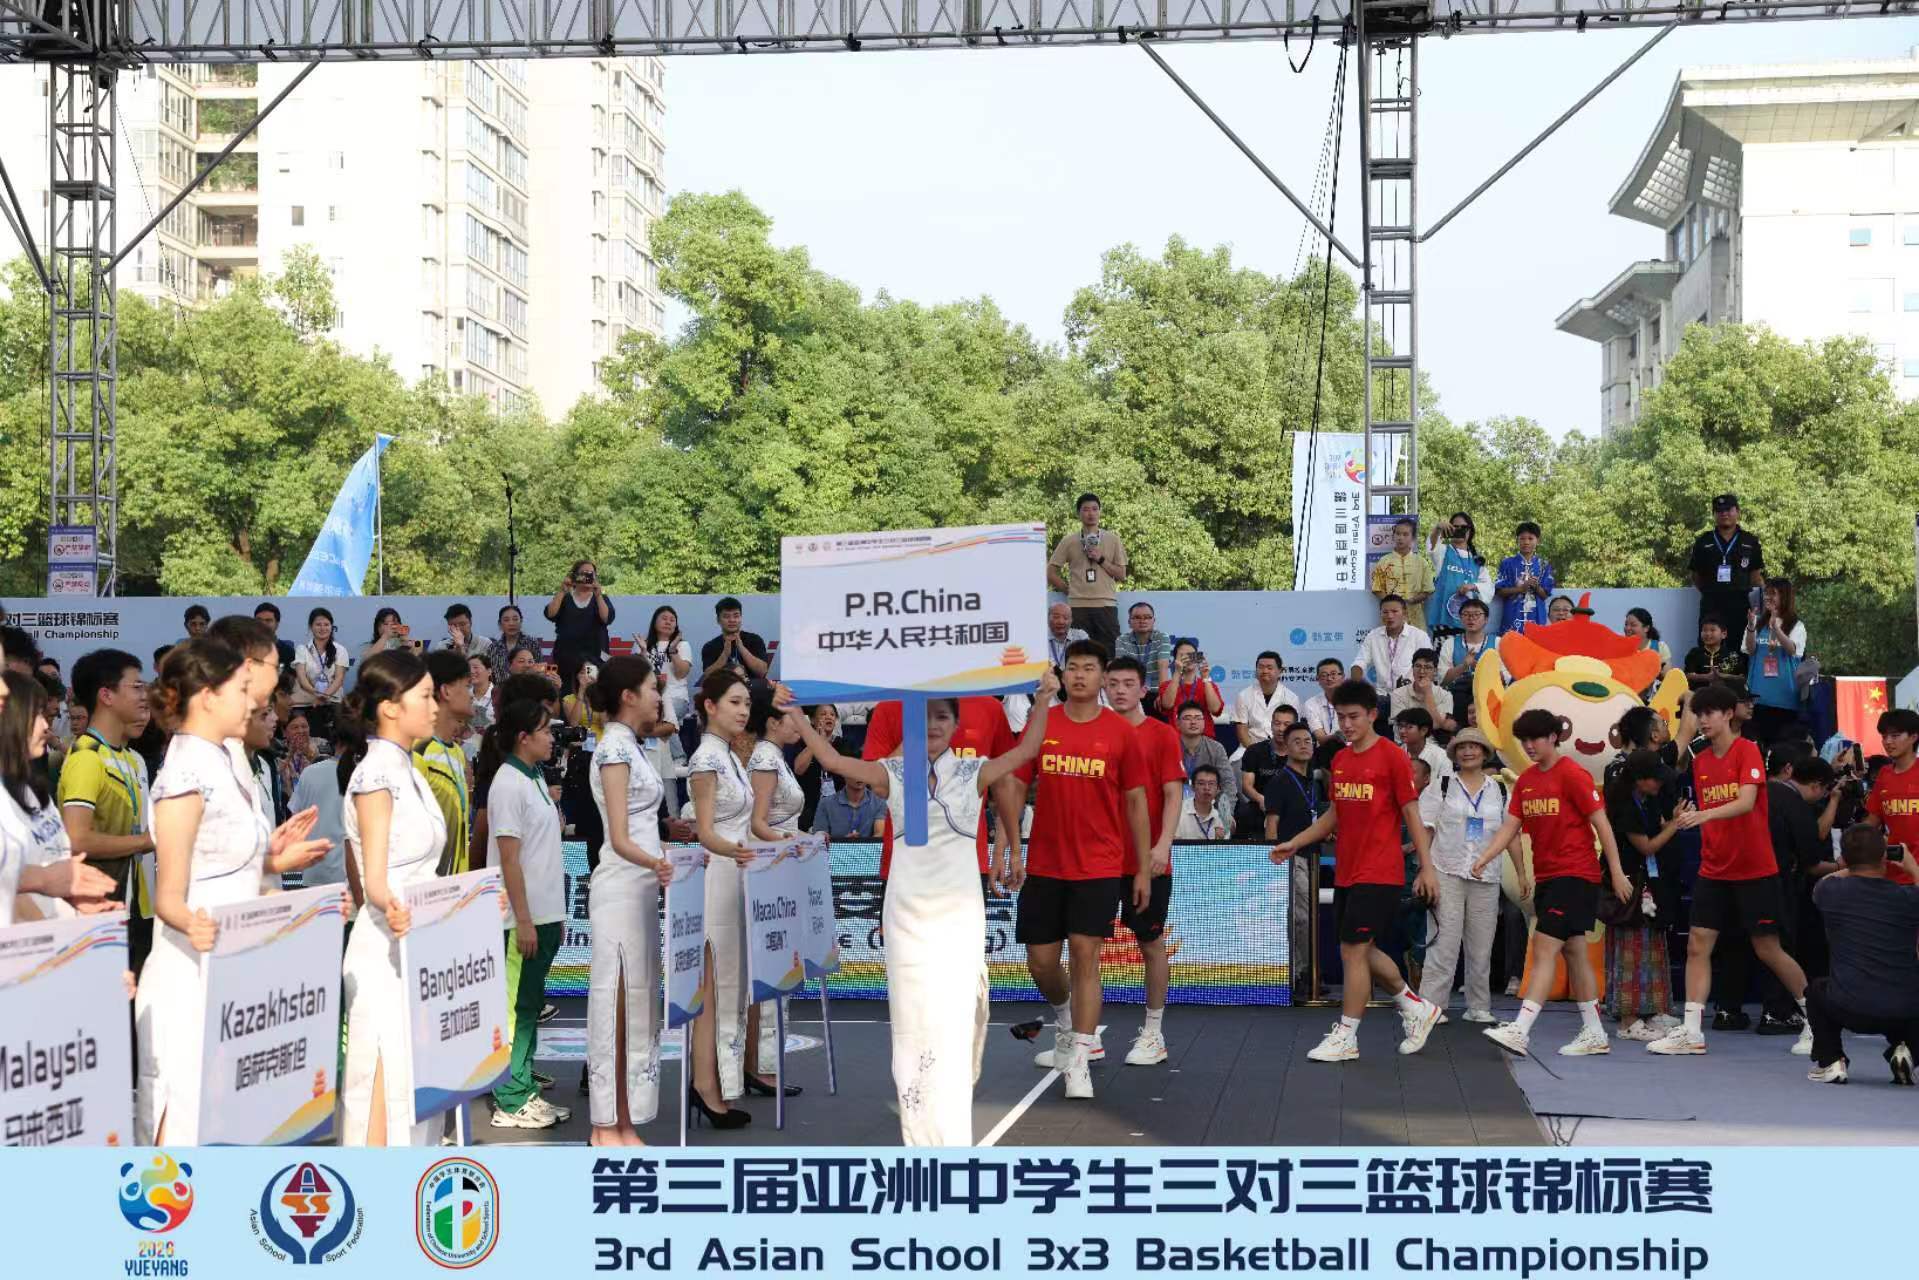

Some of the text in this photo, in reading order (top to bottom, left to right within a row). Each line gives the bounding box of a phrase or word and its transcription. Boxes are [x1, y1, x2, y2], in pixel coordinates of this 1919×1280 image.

[845, 588, 981, 617] P.R.China
[44, 629, 119, 640] Championship
[818, 621, 1009, 653] 中华人民共和国
[1042, 754, 1106, 777] CHINA
[1334, 782, 1374, 801] CHINA
[1522, 798, 1560, 816] CHINA
[419, 949, 496, 1001] Bangladesh
[220, 982, 326, 1043] Kazakhstan
[235, 1037, 307, 1092] 哈萨克斯坦
